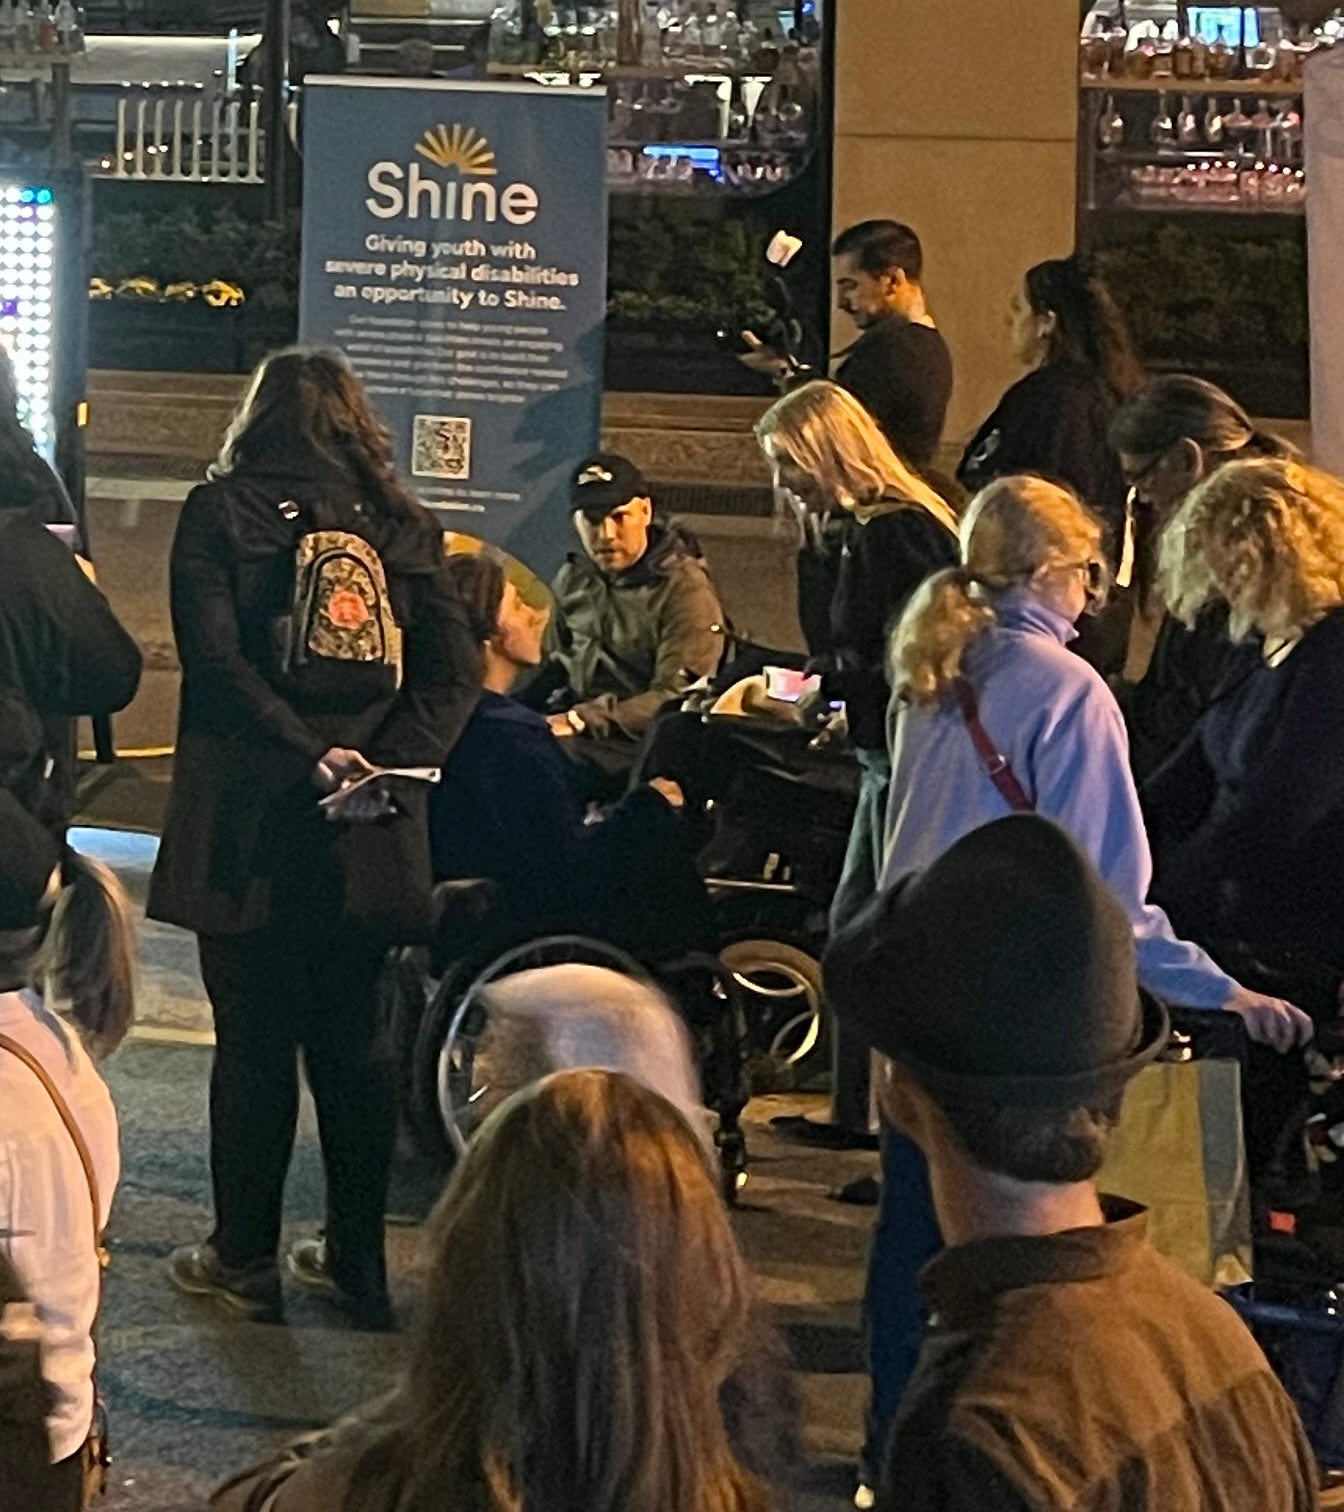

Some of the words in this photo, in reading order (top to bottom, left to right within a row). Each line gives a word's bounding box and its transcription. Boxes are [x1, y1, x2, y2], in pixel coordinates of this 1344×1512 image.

[366, 160, 538, 224] Shine
[365, 234, 426, 257] Giving
[431, 239, 486, 258] youth
[491, 240, 537, 260] with
[325, 260, 387, 276] severe
[390, 260, 467, 282] physical
[470, 264, 580, 286] disabilities
[333, 284, 358, 298] an
[361, 286, 474, 310] opportunity
[478, 289, 500, 307] to
[503, 290, 568, 311] Shine.
